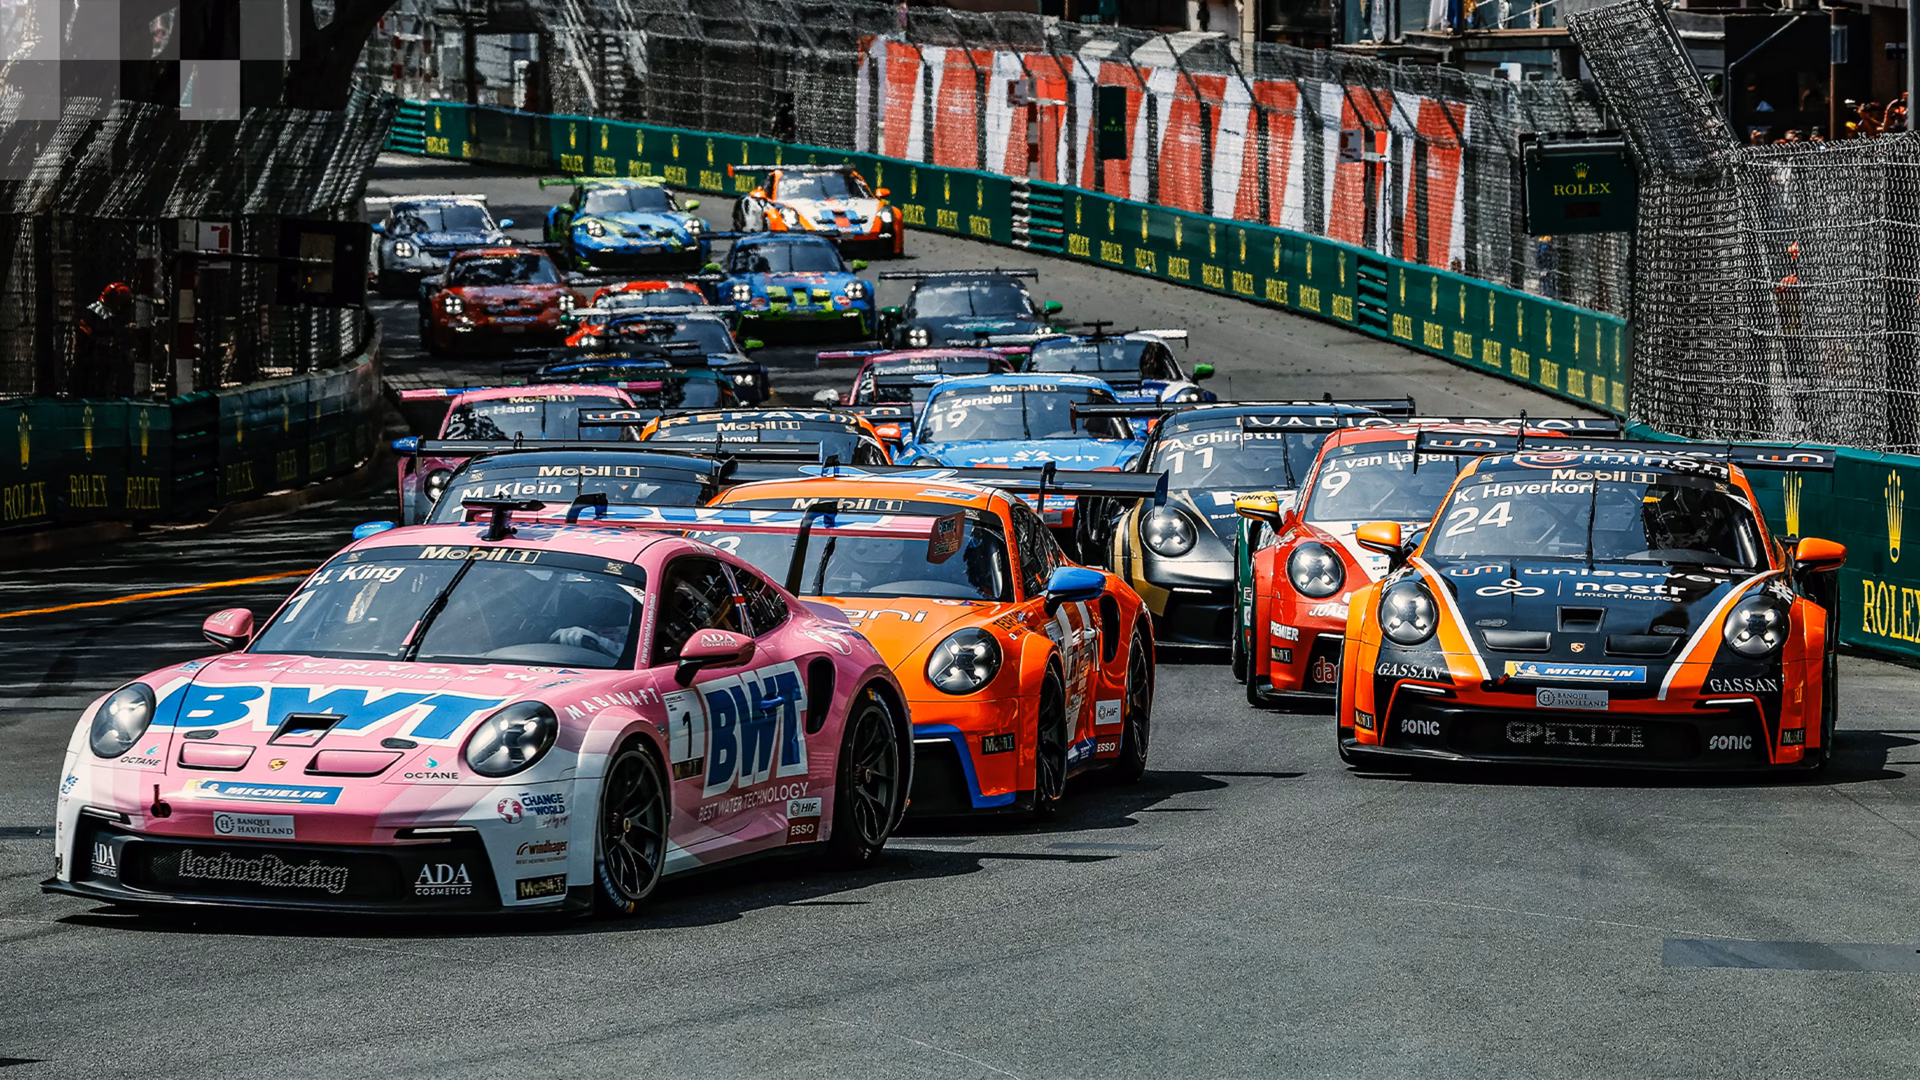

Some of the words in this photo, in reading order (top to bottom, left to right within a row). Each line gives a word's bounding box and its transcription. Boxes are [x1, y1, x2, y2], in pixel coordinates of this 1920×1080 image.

[1554, 183, 1611, 196] ROLEX
[933, 402, 948, 413] L.
[951, 395, 1013, 408] Zendell
[450, 413, 465, 425] R.
[469, 408, 489, 420] de
[494, 405, 536, 416] Haan
[928, 410, 968, 432] 19
[447, 423, 467, 440] 2
[716, 421, 777, 431] Mobil
[1166, 446, 1214, 474] 11
[1325, 459, 1340, 474] J.
[1344, 454, 1383, 468] van
[1388, 451, 1455, 466] Lagen
[538, 466, 611, 478] Mobil
[1551, 469, 1626, 483] Mobil
[70, 475, 108, 508] ROLEX
[1321, 471, 1352, 499] 9
[3, 481, 47, 521] ROLEX
[126, 477, 161, 510] ROLEX
[1237, 494, 1263, 502] VINK
[1455, 489, 1476, 506] K.
[1482, 481, 1598, 499] Haverkort
[792, 498, 873, 512] Mbil
[1446, 501, 1514, 538] 24
[418, 546, 506, 562] Mobil
[310, 572, 332, 589] H.
[337, 564, 406, 584] King
[1575, 581, 1687, 596] nestr
[1574, 591, 1620, 600] smart
[1624, 592, 1682, 603] finance
[283, 589, 317, 624] 1
[700, 634, 737, 644] ADA
[1377, 662, 1444, 680] GASSAN
[1544, 667, 1635, 677] MICHELIN
[1710, 678, 1779, 693] GASSAN
[564, 687, 662, 720] MABANAFT
[1558, 692, 1589, 700] BANQUE
[1558, 699, 1608, 708] HAVILLAND
[154, 683, 504, 742] BWT
[1105, 706, 1119, 718] HIF
[682, 711, 692, 758] 1
[704, 669, 803, 788] BWT
[1096, 741, 1116, 754] ESSO
[120, 755, 162, 767] OCTANE
[404, 770, 459, 780] OCTANE
[223, 786, 330, 801] MICHELIN
[521, 793, 564, 807] CHANGE
[698, 803, 717, 822] BEST
[718, 797, 742, 815] WATER
[743, 782, 809, 809] TECHNOLOGY
[801, 802, 817, 812] HIF
[534, 804, 566, 816] WORLD
[237, 818, 271, 827] BANQUE
[790, 824, 814, 836] ESSO
[237, 826, 294, 836] HAVILLAND
[92, 842, 117, 867] ADA
[414, 863, 472, 885] ADA
[415, 887, 472, 896] COSMETICS
